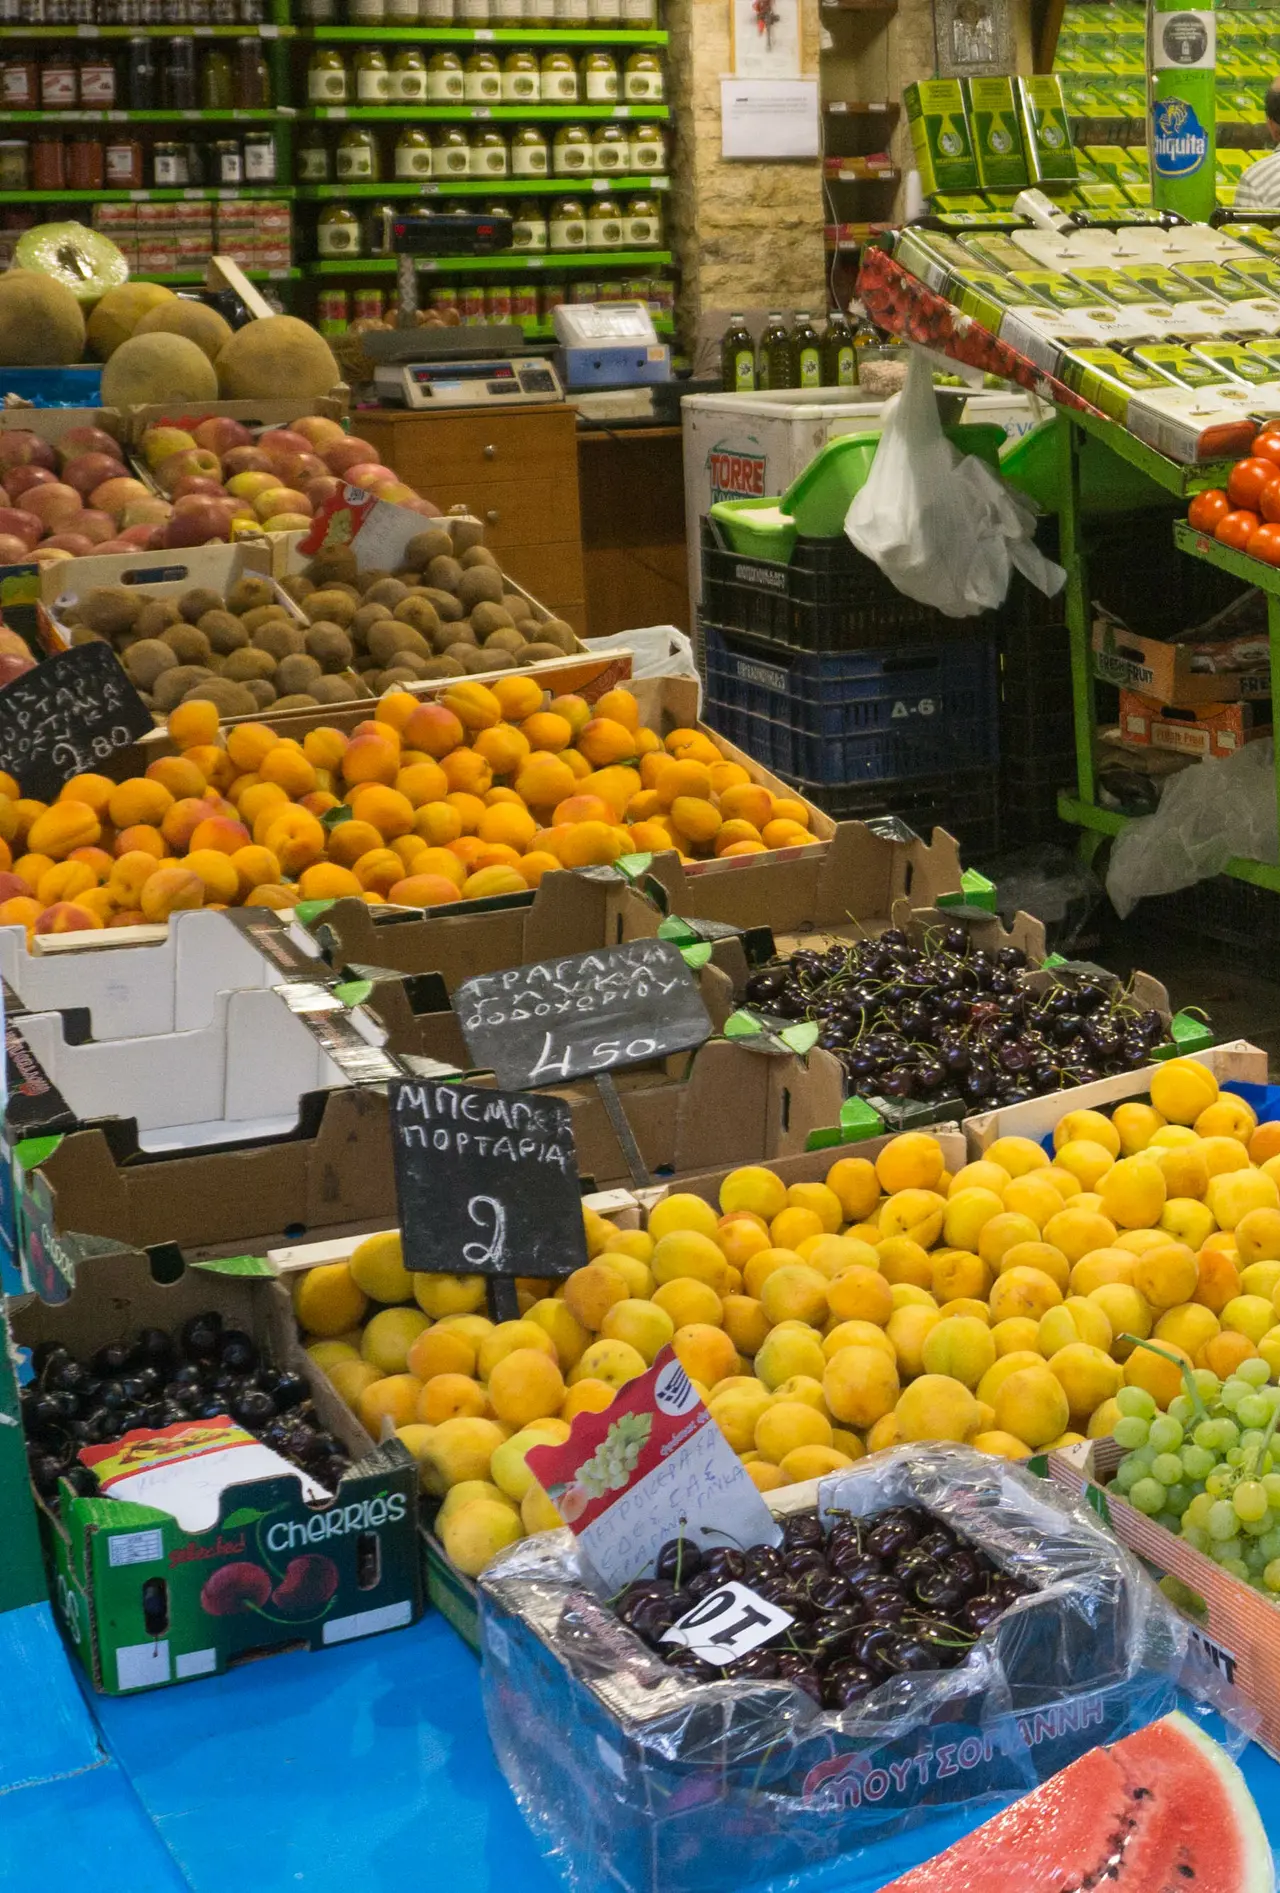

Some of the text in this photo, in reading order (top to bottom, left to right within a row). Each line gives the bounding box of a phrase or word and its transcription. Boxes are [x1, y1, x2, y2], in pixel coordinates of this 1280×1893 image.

[1155, 133, 1206, 161] hiquita
[711, 454, 764, 494] TORRE
[1127, 665, 1154, 684] FRUIT
[1239, 676, 1270, 694] FRE
[462, 1195, 506, 1271] 2
[677, 1589, 772, 1646] 10
